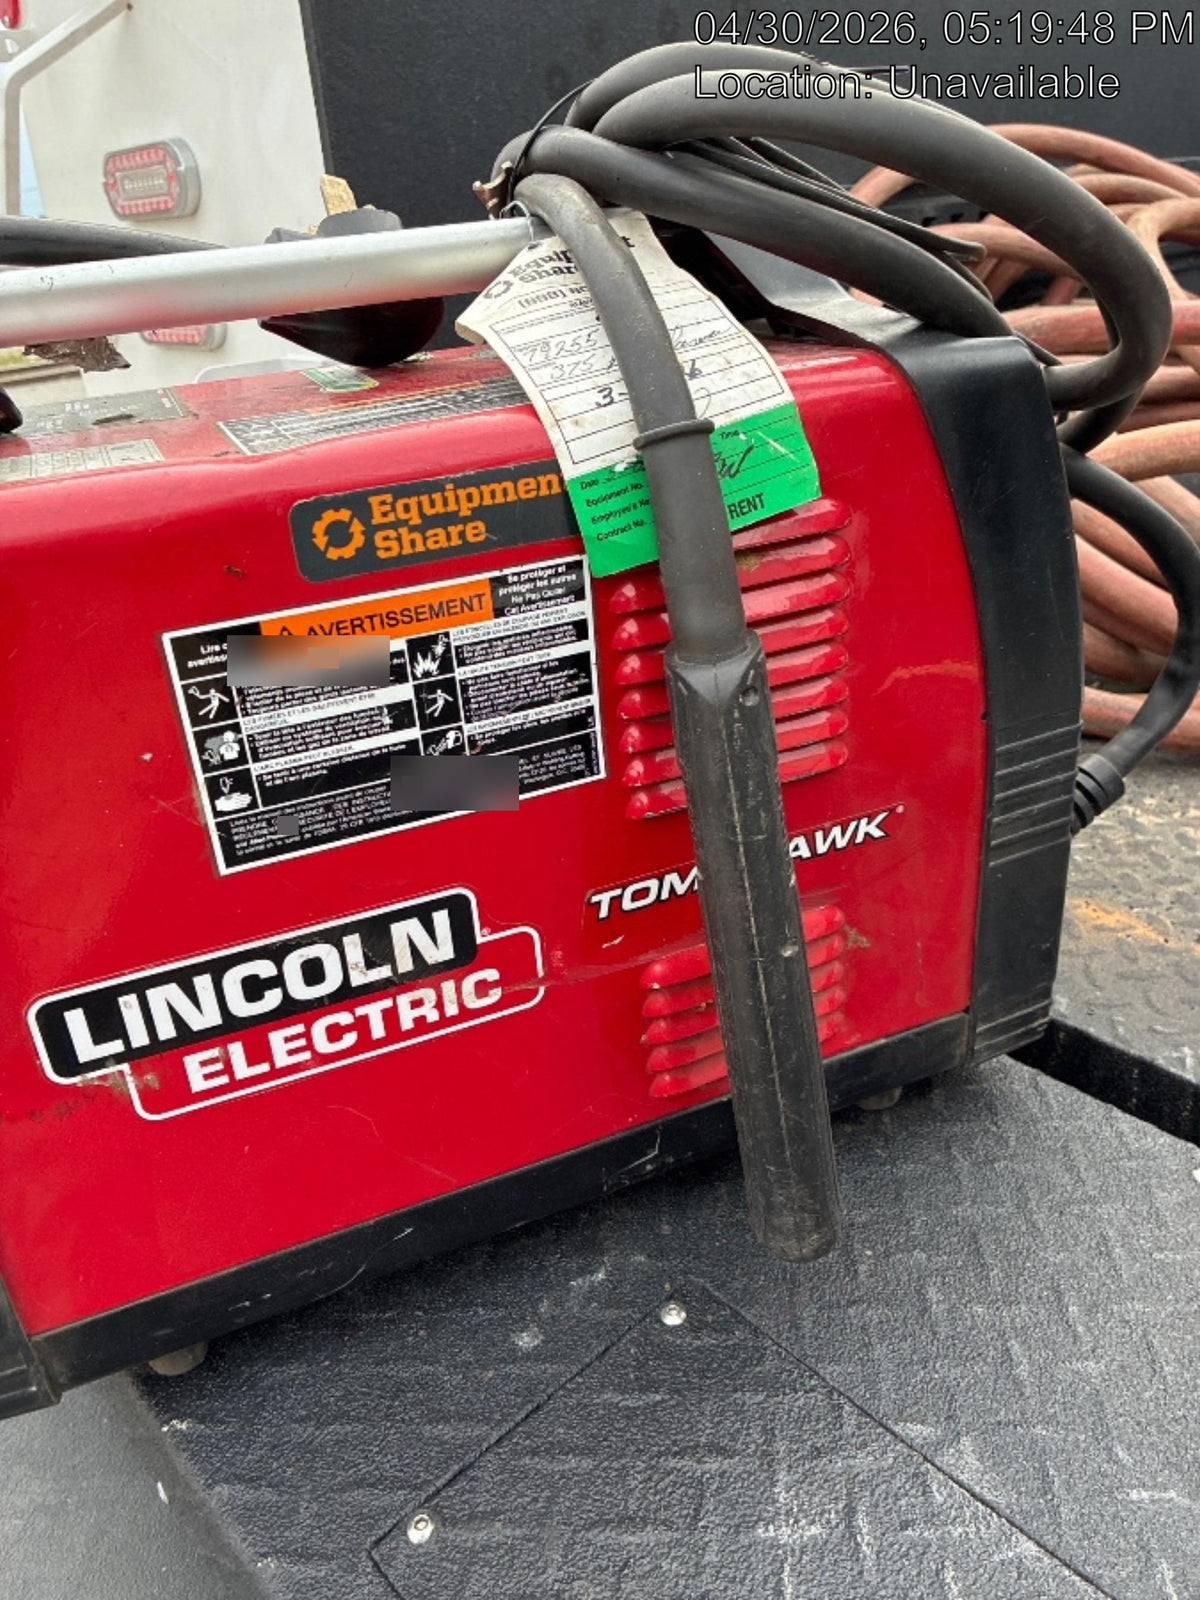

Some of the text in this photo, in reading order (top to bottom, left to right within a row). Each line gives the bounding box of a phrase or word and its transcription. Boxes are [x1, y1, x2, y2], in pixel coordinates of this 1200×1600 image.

[519, 265, 578, 283] Shar
[367, 472, 564, 526] Equipmen
[727, 492, 766, 520] RENT
[373, 519, 486, 560] Share
[589, 811, 891, 919] TOMAWK
[63, 909, 456, 1065] LINCOLN
[182, 967, 503, 1094] ELECTRIC
